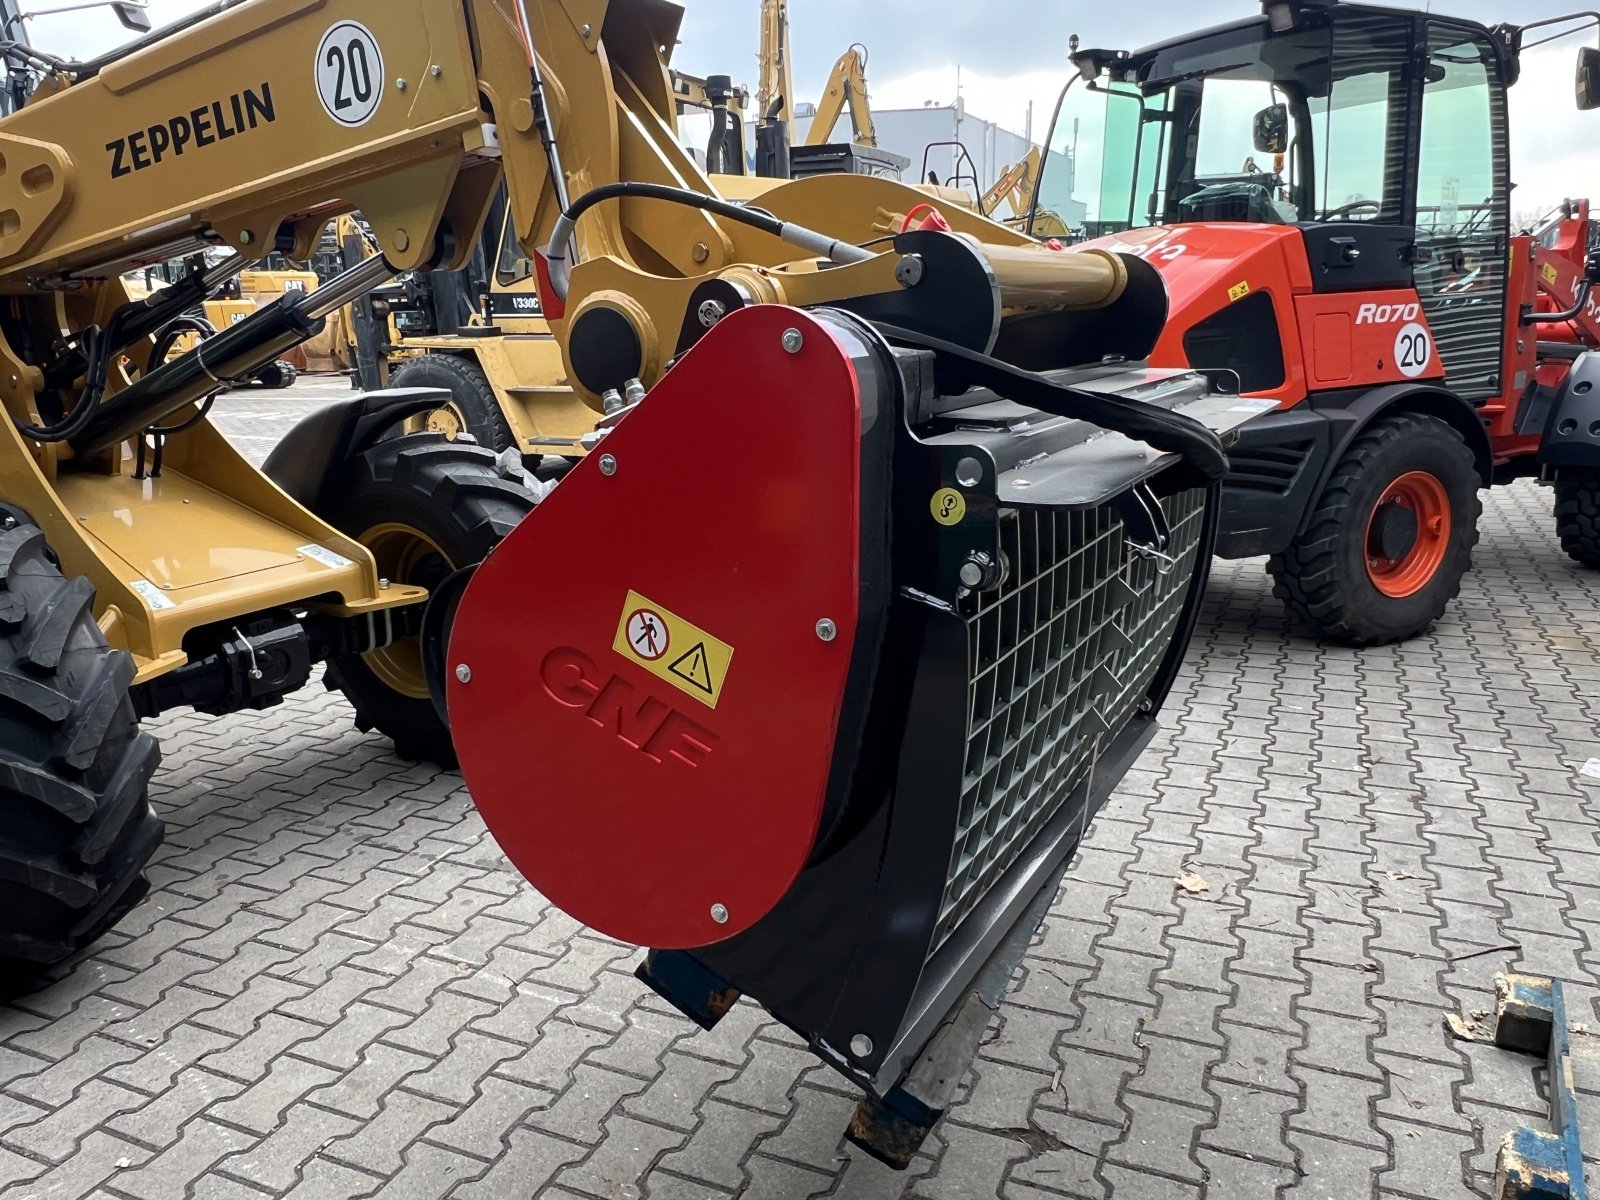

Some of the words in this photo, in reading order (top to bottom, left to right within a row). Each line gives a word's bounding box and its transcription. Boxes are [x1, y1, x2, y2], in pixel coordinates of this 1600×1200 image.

[326, 38, 372, 111] 20
[105, 82, 276, 179] ZEPPELIN
[284, 280, 304, 292] CAT
[1355, 303, 1419, 325] R070
[1400, 333, 1426, 368] 20
[539, 645, 720, 767] CNF
